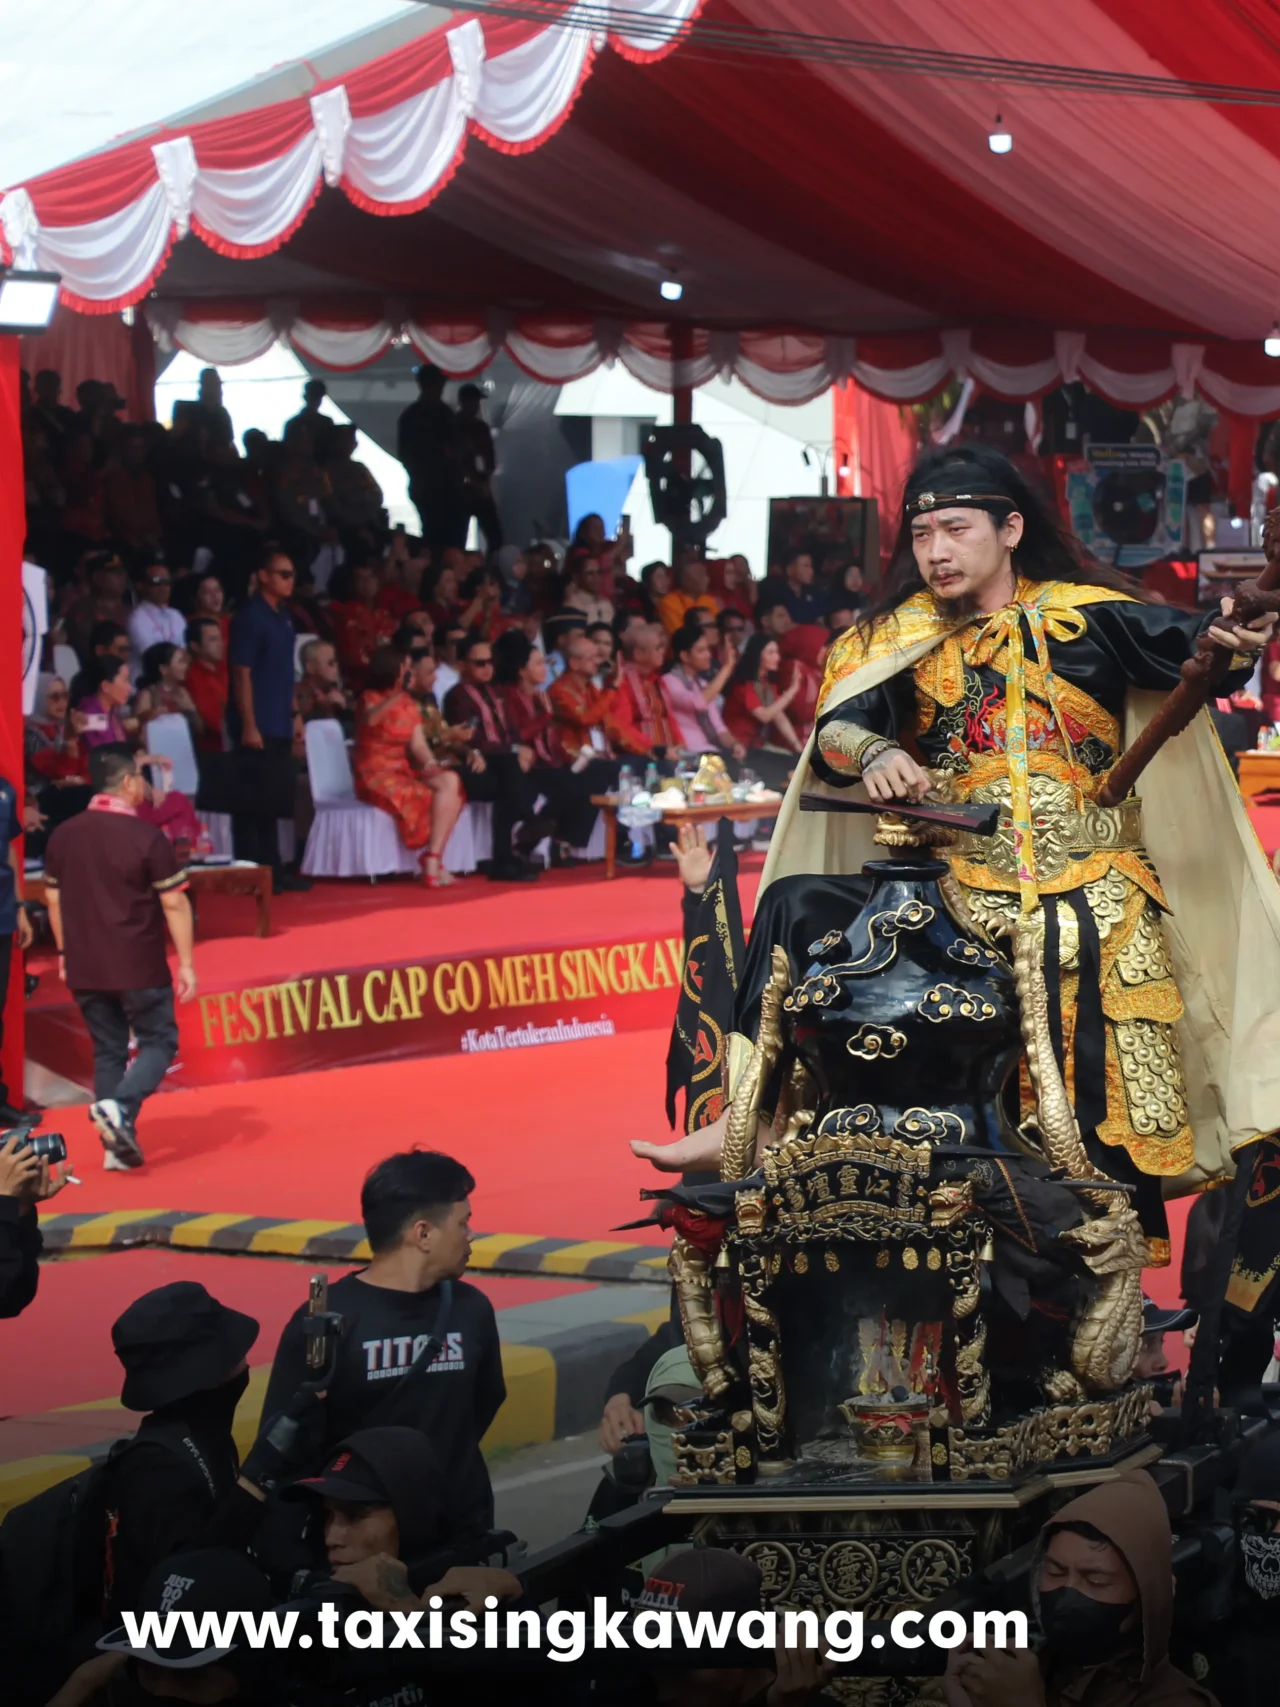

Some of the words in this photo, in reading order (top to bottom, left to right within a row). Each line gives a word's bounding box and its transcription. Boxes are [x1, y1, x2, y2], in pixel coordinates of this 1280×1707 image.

[199, 975, 363, 1048] FESTIVAL
[363, 966, 428, 1023] CAP
[433, 959, 482, 1015] GO
[485, 952, 560, 1010] MEH
[461, 1013, 615, 1053] #KotaTertoleranIndonesia
[161, 1586, 183, 1602] DO
[163, 1573, 196, 1591] JUST
